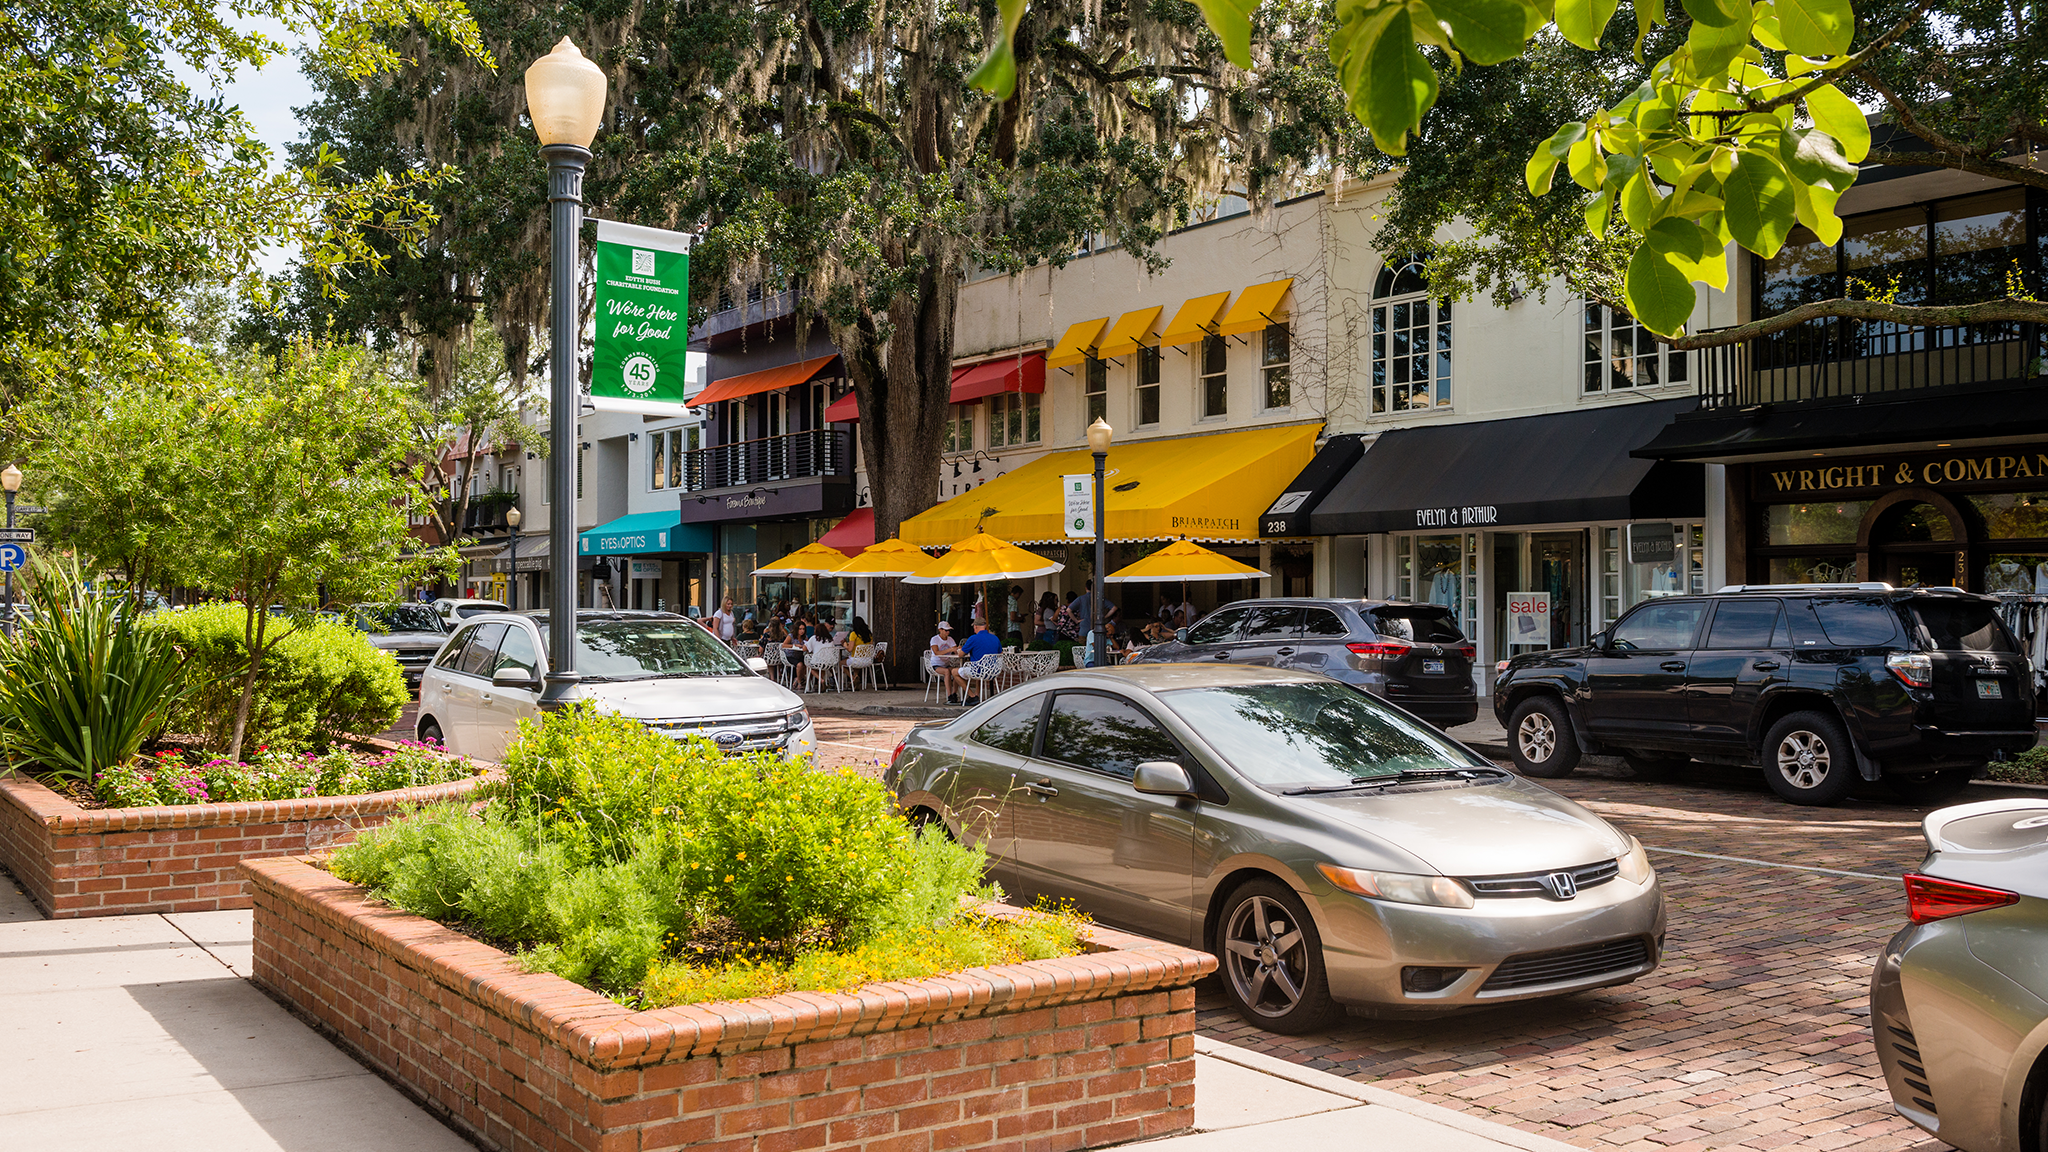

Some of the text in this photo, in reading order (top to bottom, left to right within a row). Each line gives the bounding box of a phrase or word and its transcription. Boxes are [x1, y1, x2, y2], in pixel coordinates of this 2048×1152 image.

[606, 280, 679, 295] CHARITABLE FOUNDATION
[625, 275, 645, 283] EDYTH
[606, 299, 678, 321] We're Here
[612, 321, 672, 342] for Good
[620, 351, 660, 372] COMMEMORATING
[629, 363, 650, 381] 45
[1771, 464, 1885, 492] WRIGHT
[1894, 462, 1915, 485] &
[1172, 516, 1239, 530] BRIARPATCH
[1416, 505, 1497, 527] EVELYN & ARTHUR
[1267, 520, 1287, 533] 238
[0, 548, 17, 567] P
[1510, 596, 1548, 614] sale
